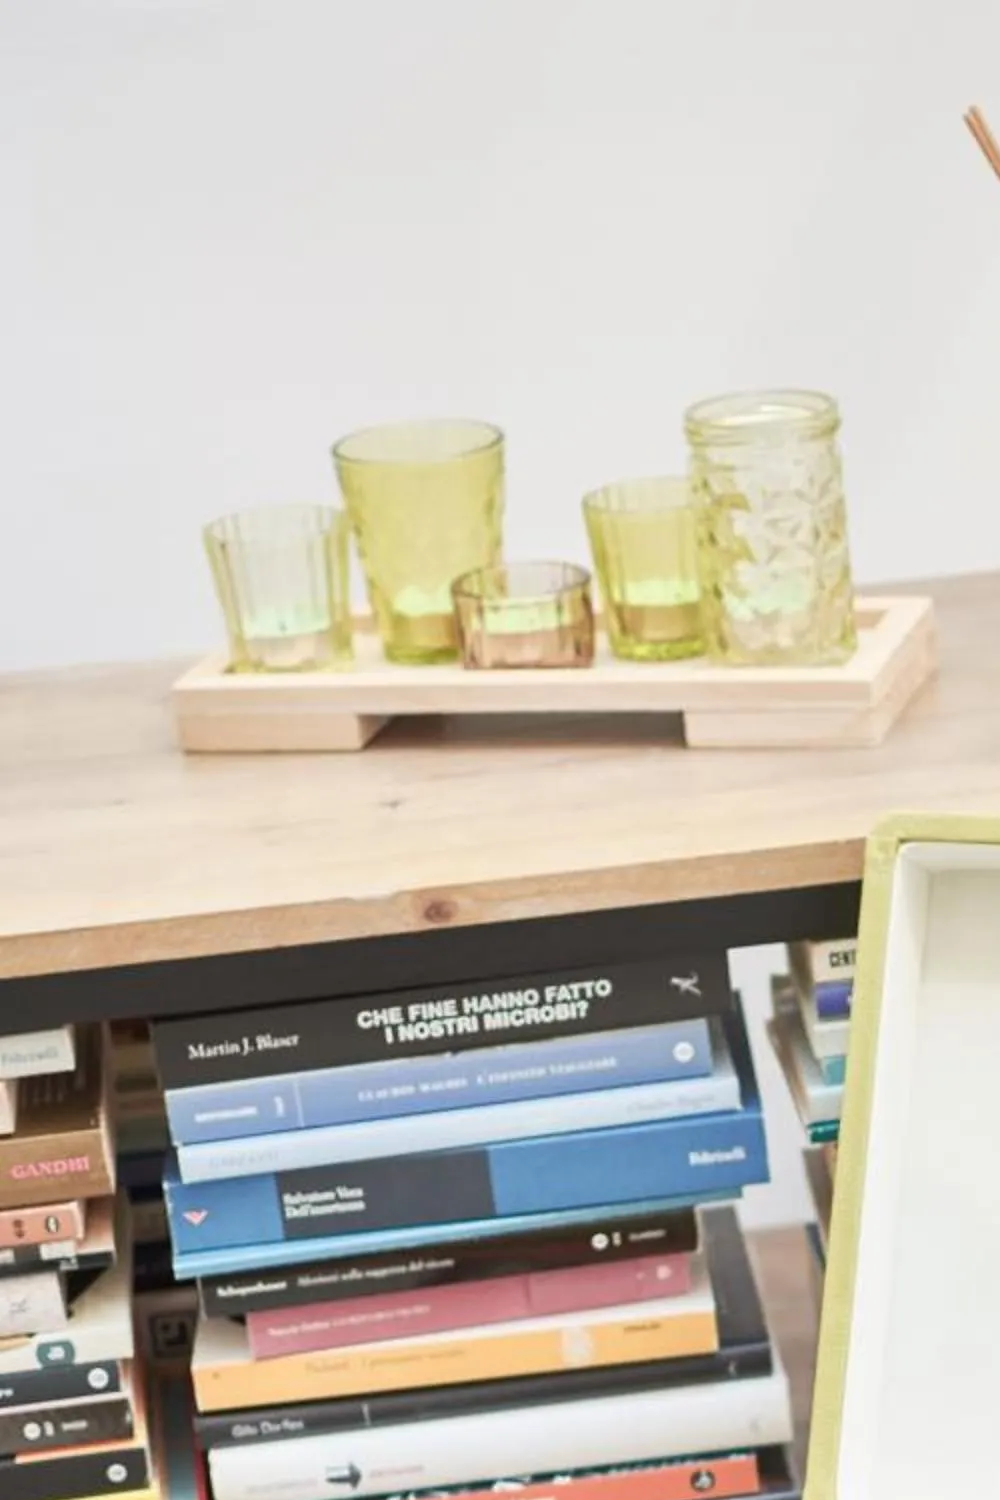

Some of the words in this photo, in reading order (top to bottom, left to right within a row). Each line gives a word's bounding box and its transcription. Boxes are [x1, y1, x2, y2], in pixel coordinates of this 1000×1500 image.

[356, 1005, 404, 1029] CHE
[408, 998, 458, 1023] FINE
[462, 988, 541, 1014] HANNO
[545, 979, 613, 1004] FATTO
[385, 1026, 394, 1044] I
[398, 1016, 479, 1044] NOSTRI
[484, 1001, 590, 1032] MICROBI?
[188, 1038, 241, 1061] Martin
[242, 1037, 254, 1056] J.
[256, 1032, 300, 1052] Blaser
[10, 1155, 91, 1180] GANDHI
